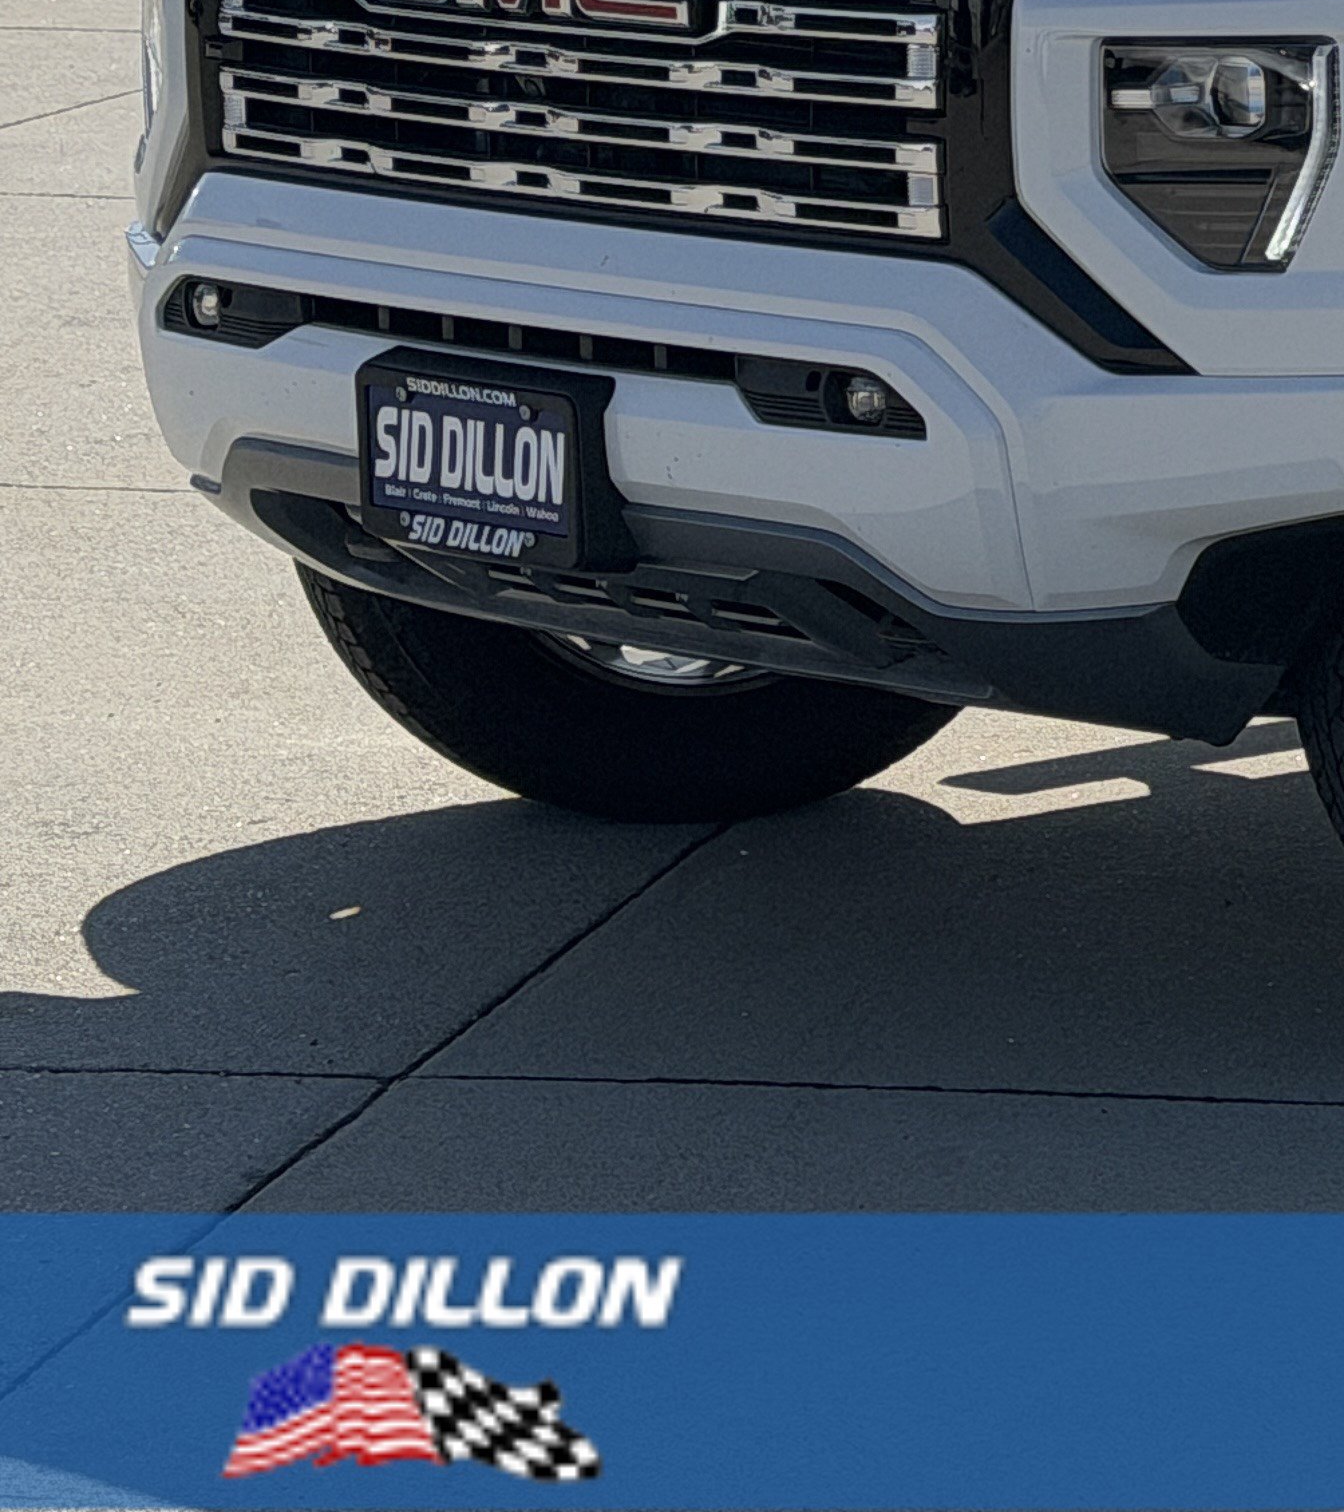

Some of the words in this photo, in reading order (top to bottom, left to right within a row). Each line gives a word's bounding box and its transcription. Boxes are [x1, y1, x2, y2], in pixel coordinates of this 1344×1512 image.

[405, 376, 517, 408] SIDDILLON.COM
[374, 406, 433, 484] SID
[440, 416, 566, 505] DILLON
[486, 500, 520, 516] Lincoln
[408, 514, 443, 545] SID
[446, 520, 526, 558] DILLON
